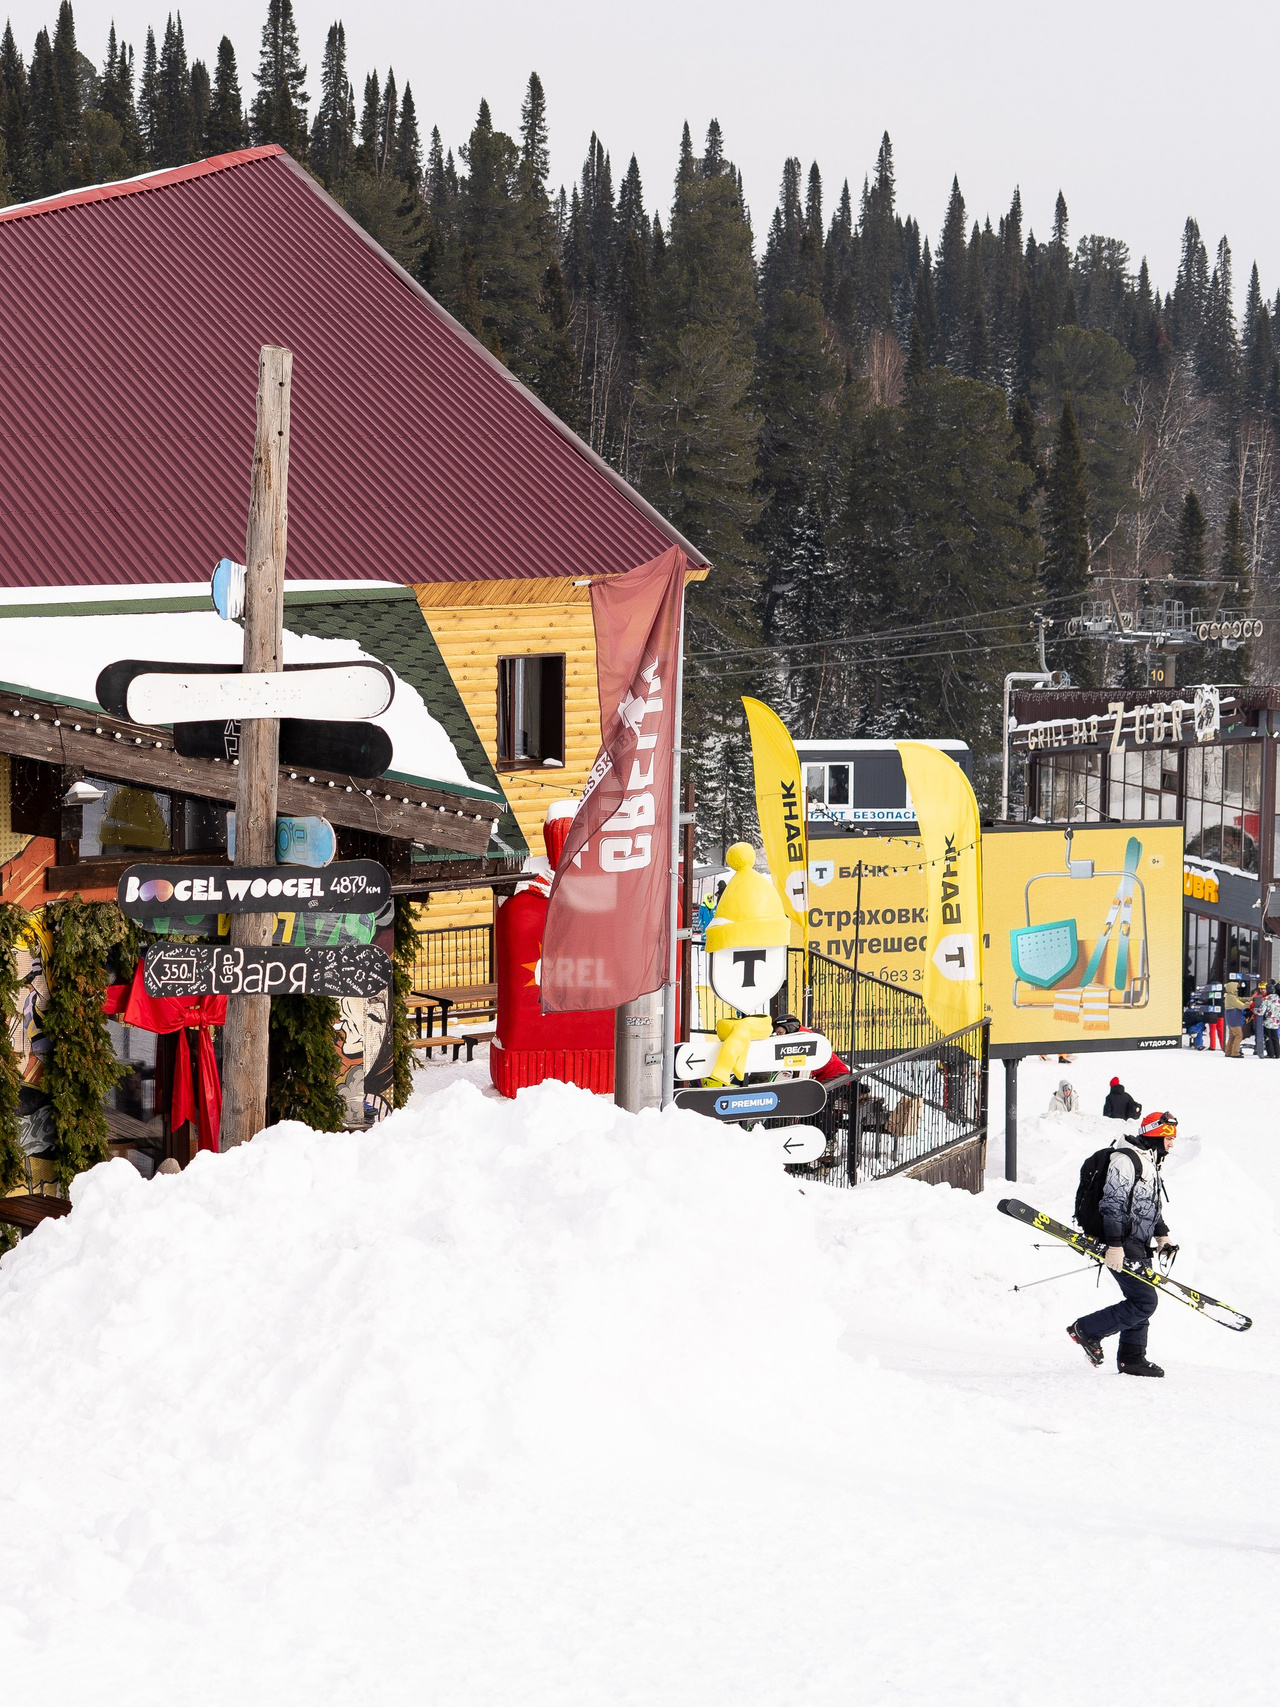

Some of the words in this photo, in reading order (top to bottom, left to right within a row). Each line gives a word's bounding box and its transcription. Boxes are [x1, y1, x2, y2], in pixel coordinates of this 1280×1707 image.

[1151, 669, 1164, 682] 10
[1028, 726, 1067, 750] GRILL
[1072, 720, 1098, 745] BAR
[1107, 701, 1184, 755] ZUBR
[838, 865, 889, 879] БАНК
[160, 963, 188, 981] 350
[879, 965, 908, 983] без
[912, 968, 924, 982] з
[780, 1044, 811, 1056] КВЕСТ
[1140, 1039, 1177, 1048] АУТДОР.РФ
[731, 1097, 773, 1109] PREMIUM
